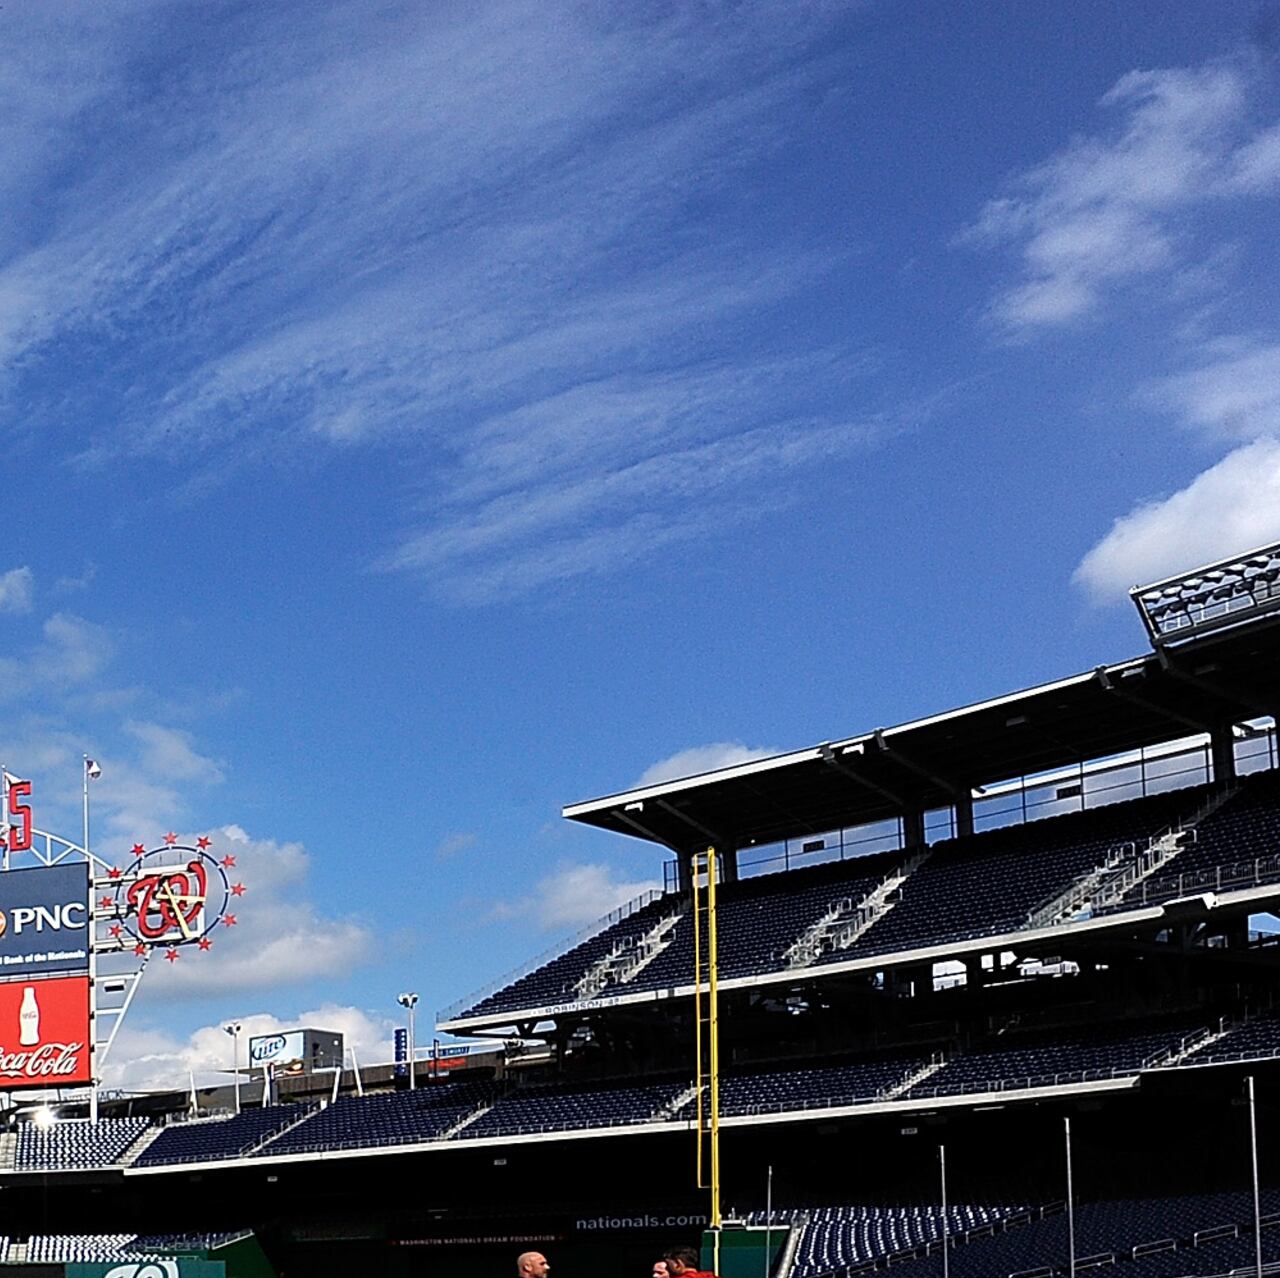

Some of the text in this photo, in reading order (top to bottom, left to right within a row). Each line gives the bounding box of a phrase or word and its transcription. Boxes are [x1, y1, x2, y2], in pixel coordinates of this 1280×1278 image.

[10, 903, 86, 934] PNC
[4, 955, 23, 965] Bank
[25, 954, 33, 962] of
[34, 953, 47, 962] the
[48, 950, 86, 961] Nationals
[575, 1214, 708, 1230] nationals.com
[399, 1238, 441, 1247] WASHINGTON
[443, 1236, 481, 1245] NATIONALS
[510, 1234, 556, 1243] FOUNDATION
